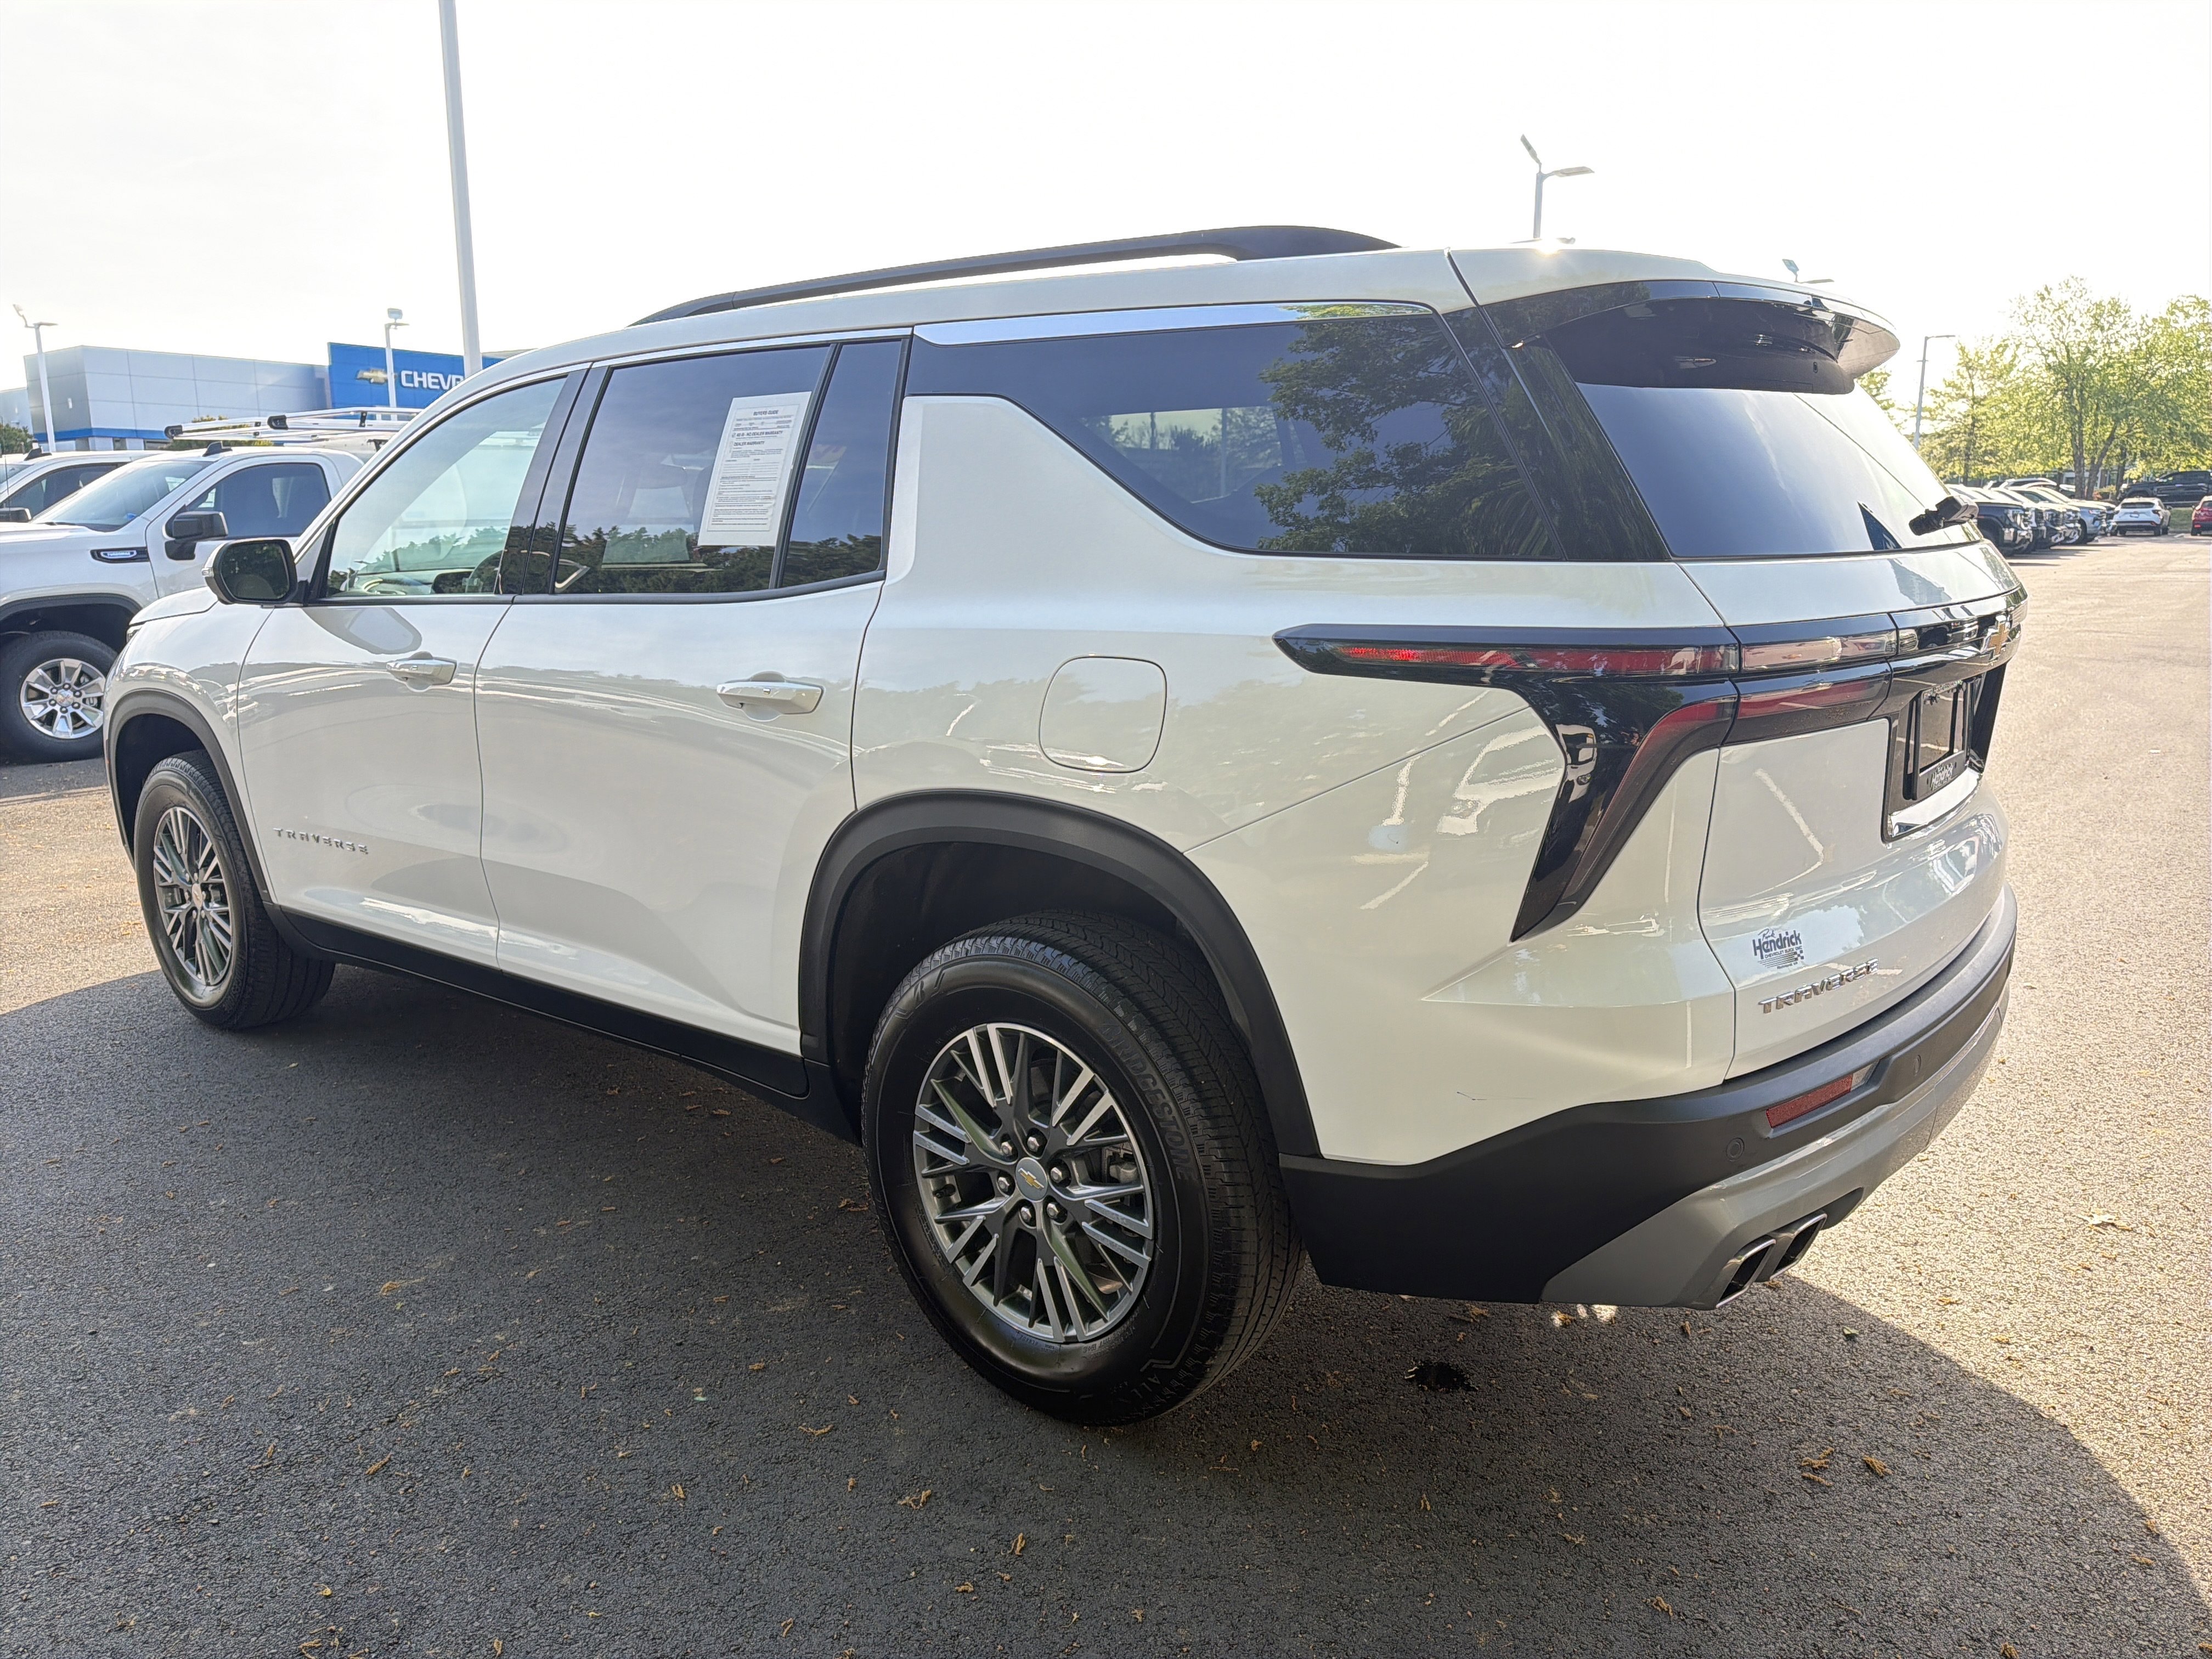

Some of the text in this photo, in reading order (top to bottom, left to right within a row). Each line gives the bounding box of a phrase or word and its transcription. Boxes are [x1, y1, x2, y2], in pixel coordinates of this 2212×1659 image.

[273, 827, 369, 855] TRAVERSE
[1752, 929, 1802, 960] Hendrick
[1758, 957, 1880, 1014] TRAVERSE
[1097, 1023, 1194, 1181] BRIDGESTONE
